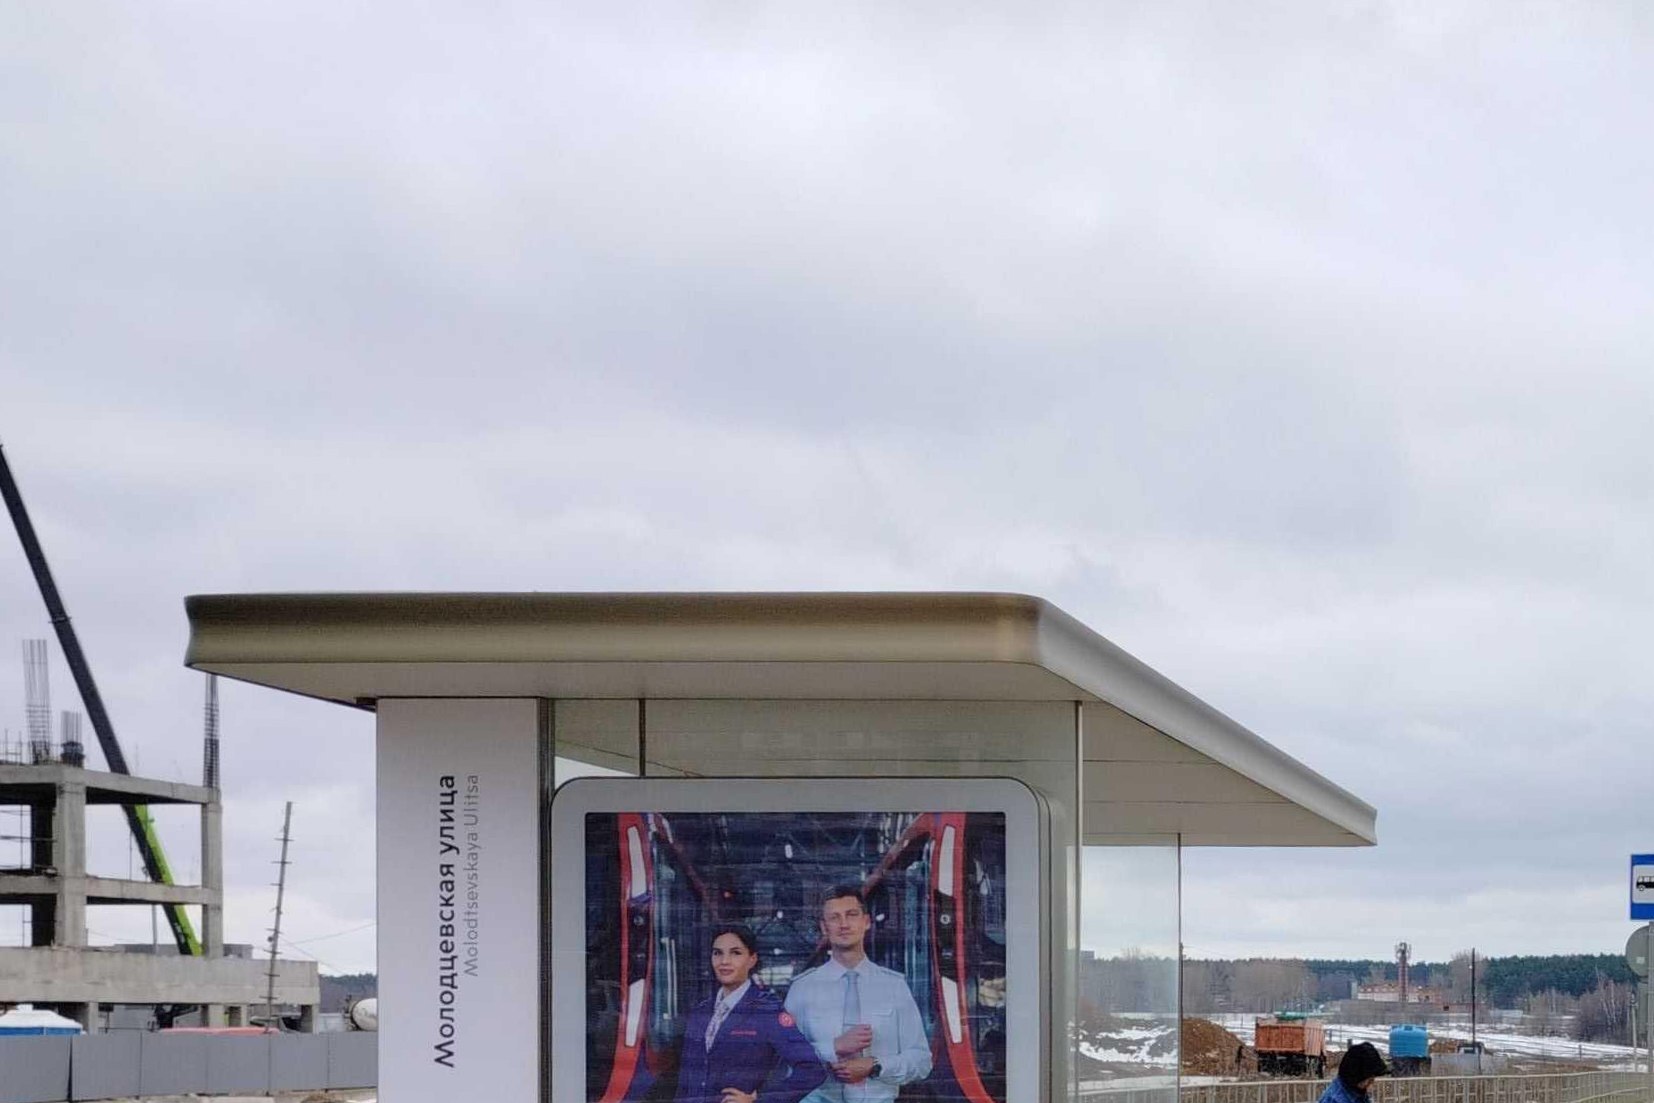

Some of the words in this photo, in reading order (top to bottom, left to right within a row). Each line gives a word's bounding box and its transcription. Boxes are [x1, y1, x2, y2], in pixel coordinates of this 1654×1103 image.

[440, 775, 460, 855] улица
[464, 775, 479, 826] Ulitsa
[463, 832, 482, 977] Molodtsevskaya
[434, 863, 458, 1068] Молодцевская
